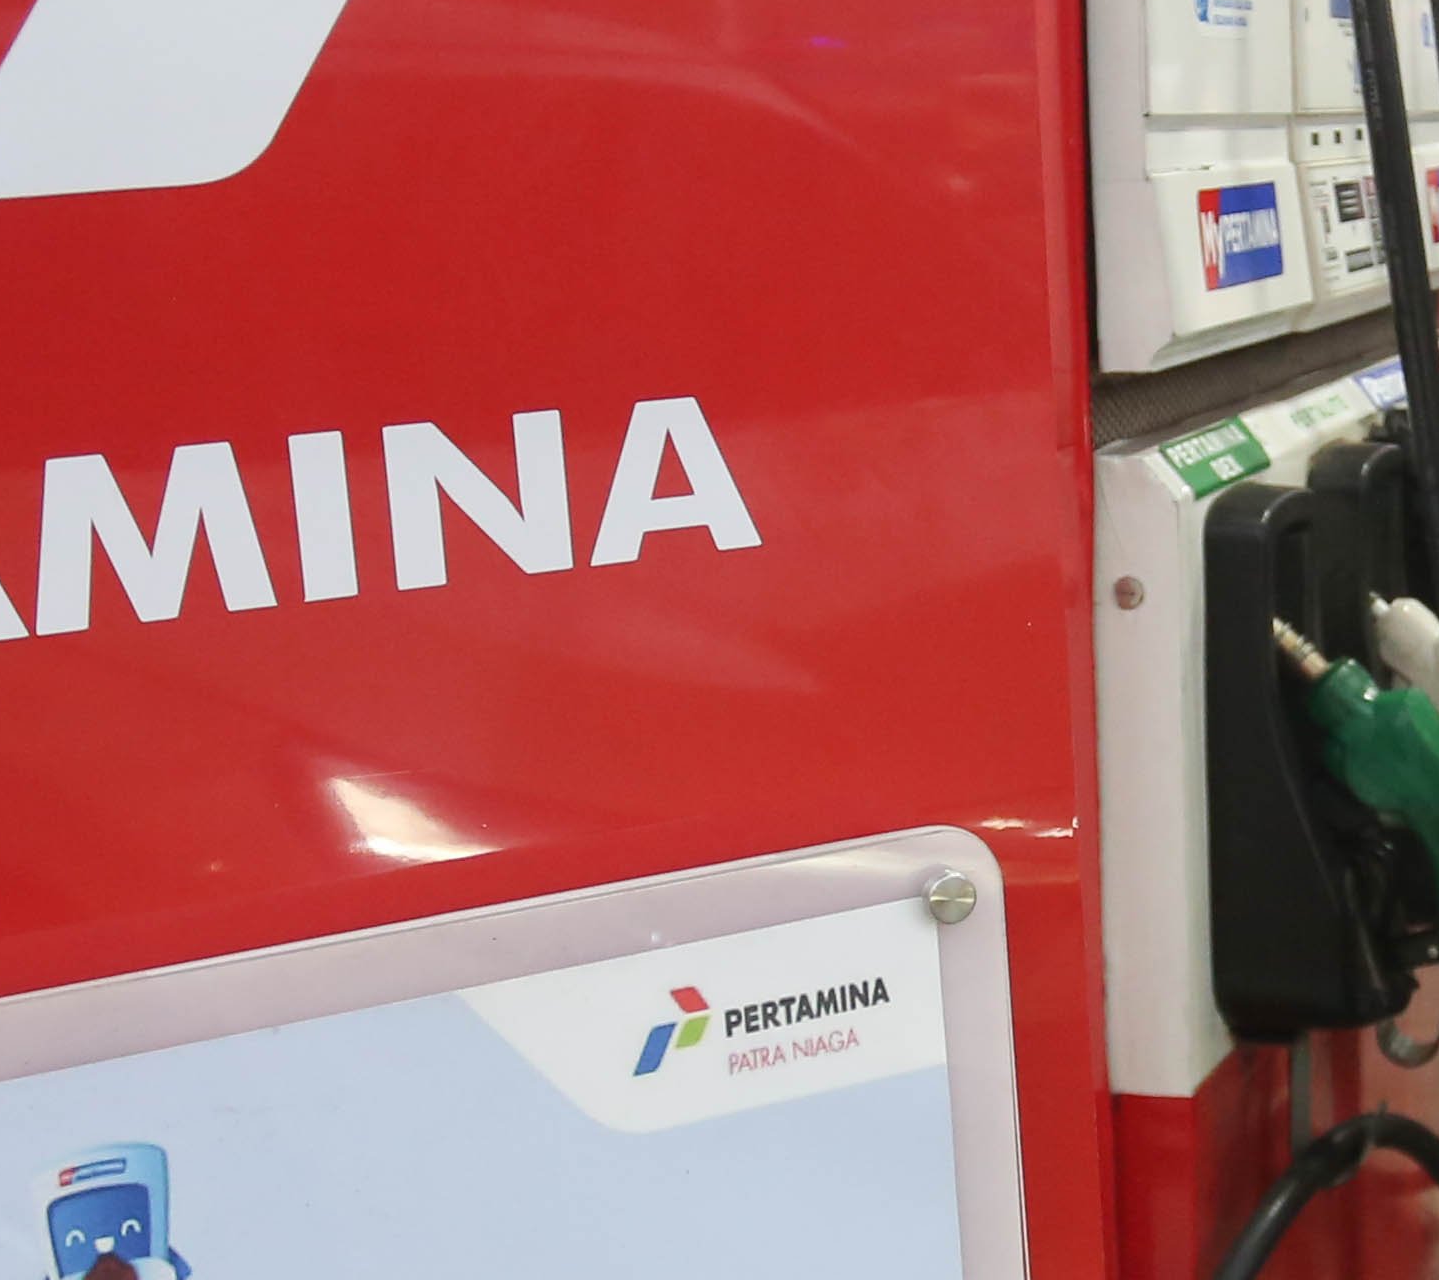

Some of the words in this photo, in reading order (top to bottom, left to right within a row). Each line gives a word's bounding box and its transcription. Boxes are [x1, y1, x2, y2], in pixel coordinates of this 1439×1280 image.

[724, 977, 890, 1037] PERTAMINA
[728, 1045, 786, 1075] PATRA
[793, 1028, 860, 1058] NIAGA
